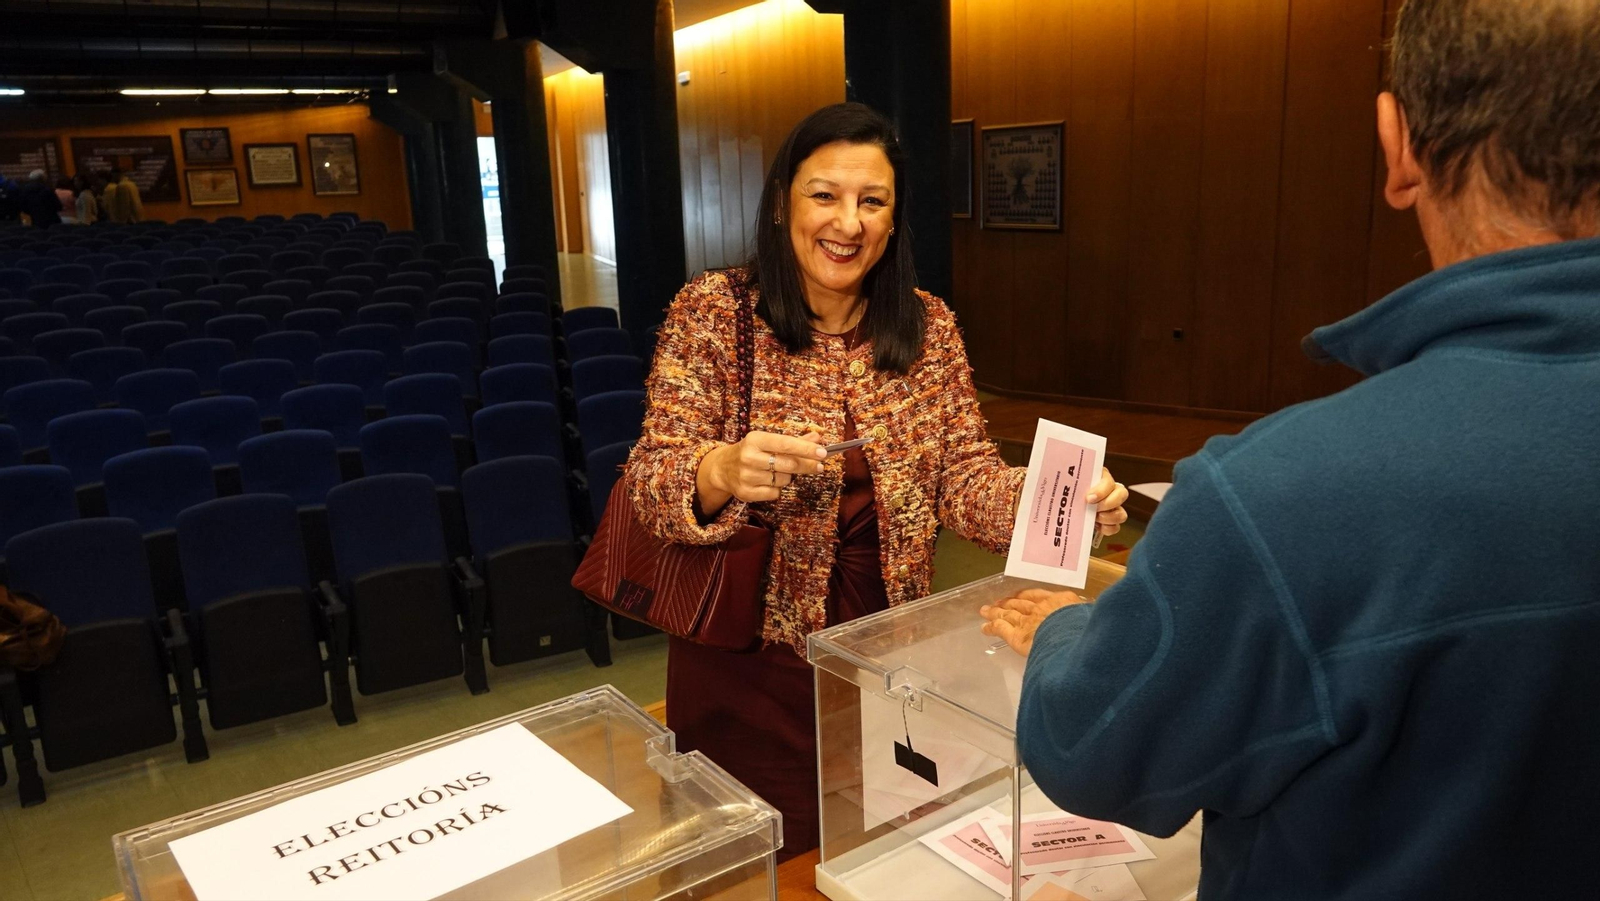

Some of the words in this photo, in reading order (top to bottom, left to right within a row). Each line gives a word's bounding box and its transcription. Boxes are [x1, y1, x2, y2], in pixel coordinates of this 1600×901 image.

[1053, 485, 1070, 547] SECTOR
[1068, 465, 1075, 477] A
[272, 771, 492, 860] ELECCIÓNS
[306, 802, 508, 886] REITORÍA
[1031, 835, 1088, 848] SECTOR
[1095, 833, 1106, 841] A
